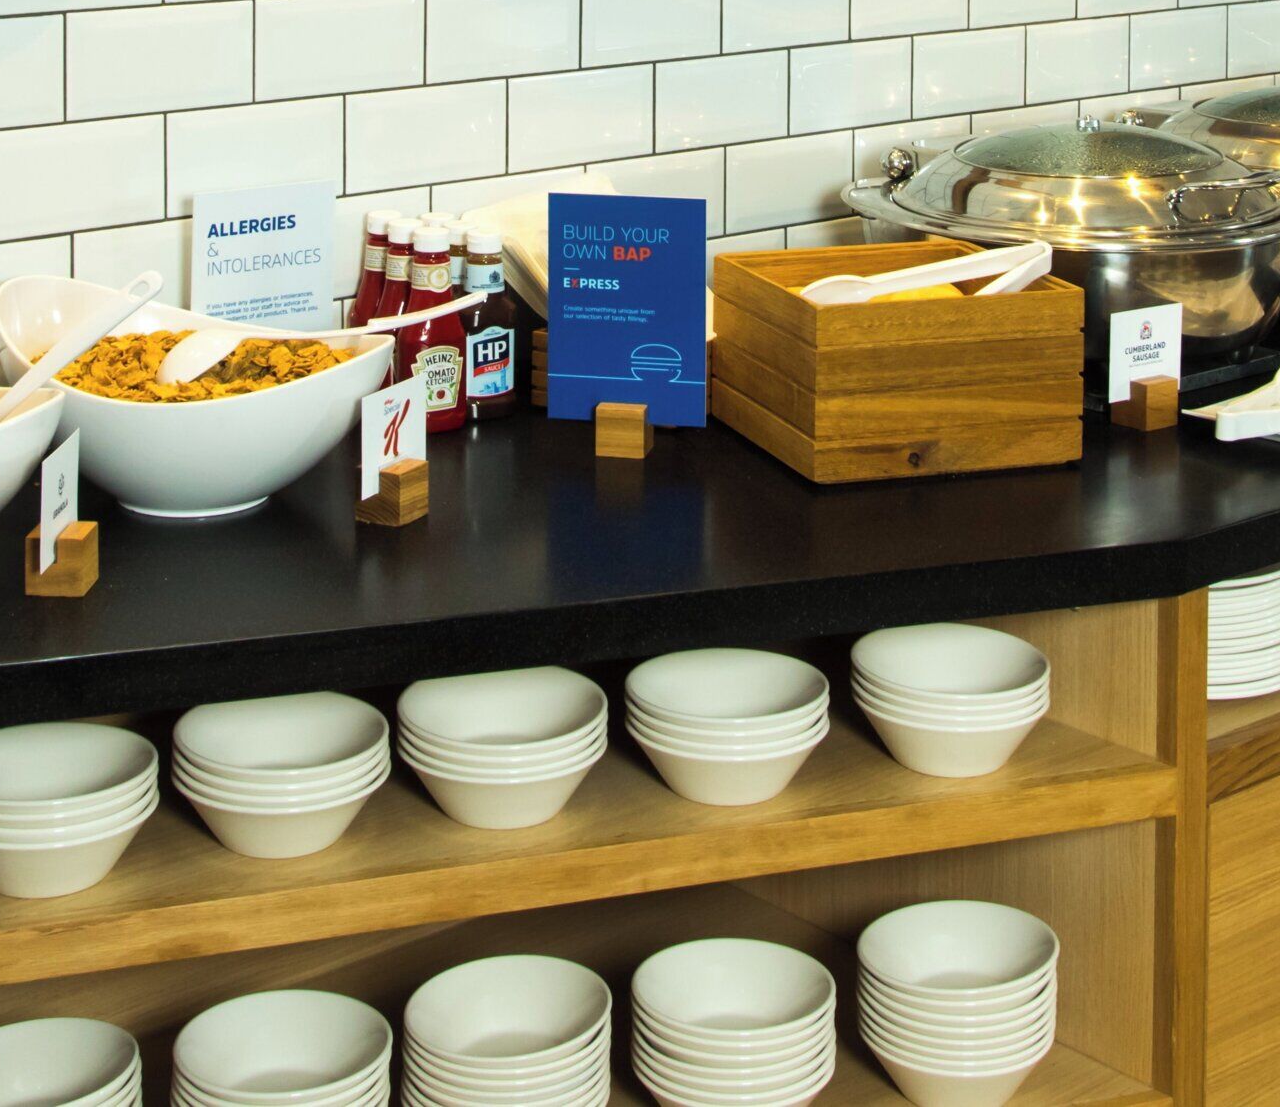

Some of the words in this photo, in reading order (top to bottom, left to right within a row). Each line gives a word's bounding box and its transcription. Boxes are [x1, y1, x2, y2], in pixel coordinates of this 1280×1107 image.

[207, 214, 296, 239] ALLERGIES
[563, 224, 615, 242] BUILD
[621, 227, 670, 244] YOUR
[207, 242, 219, 258] &
[563, 244, 607, 260] OWN
[613, 245, 652, 262] BAP
[207, 248, 321, 276] INTOLERANCES
[563, 277, 620, 291] EXPRESS
[477, 340, 507, 362] HP
[1124, 341, 1166, 355] CUMBERLAND
[425, 354, 453, 366] HEINZ
[1132, 351, 1160, 363] SAUSAGE
